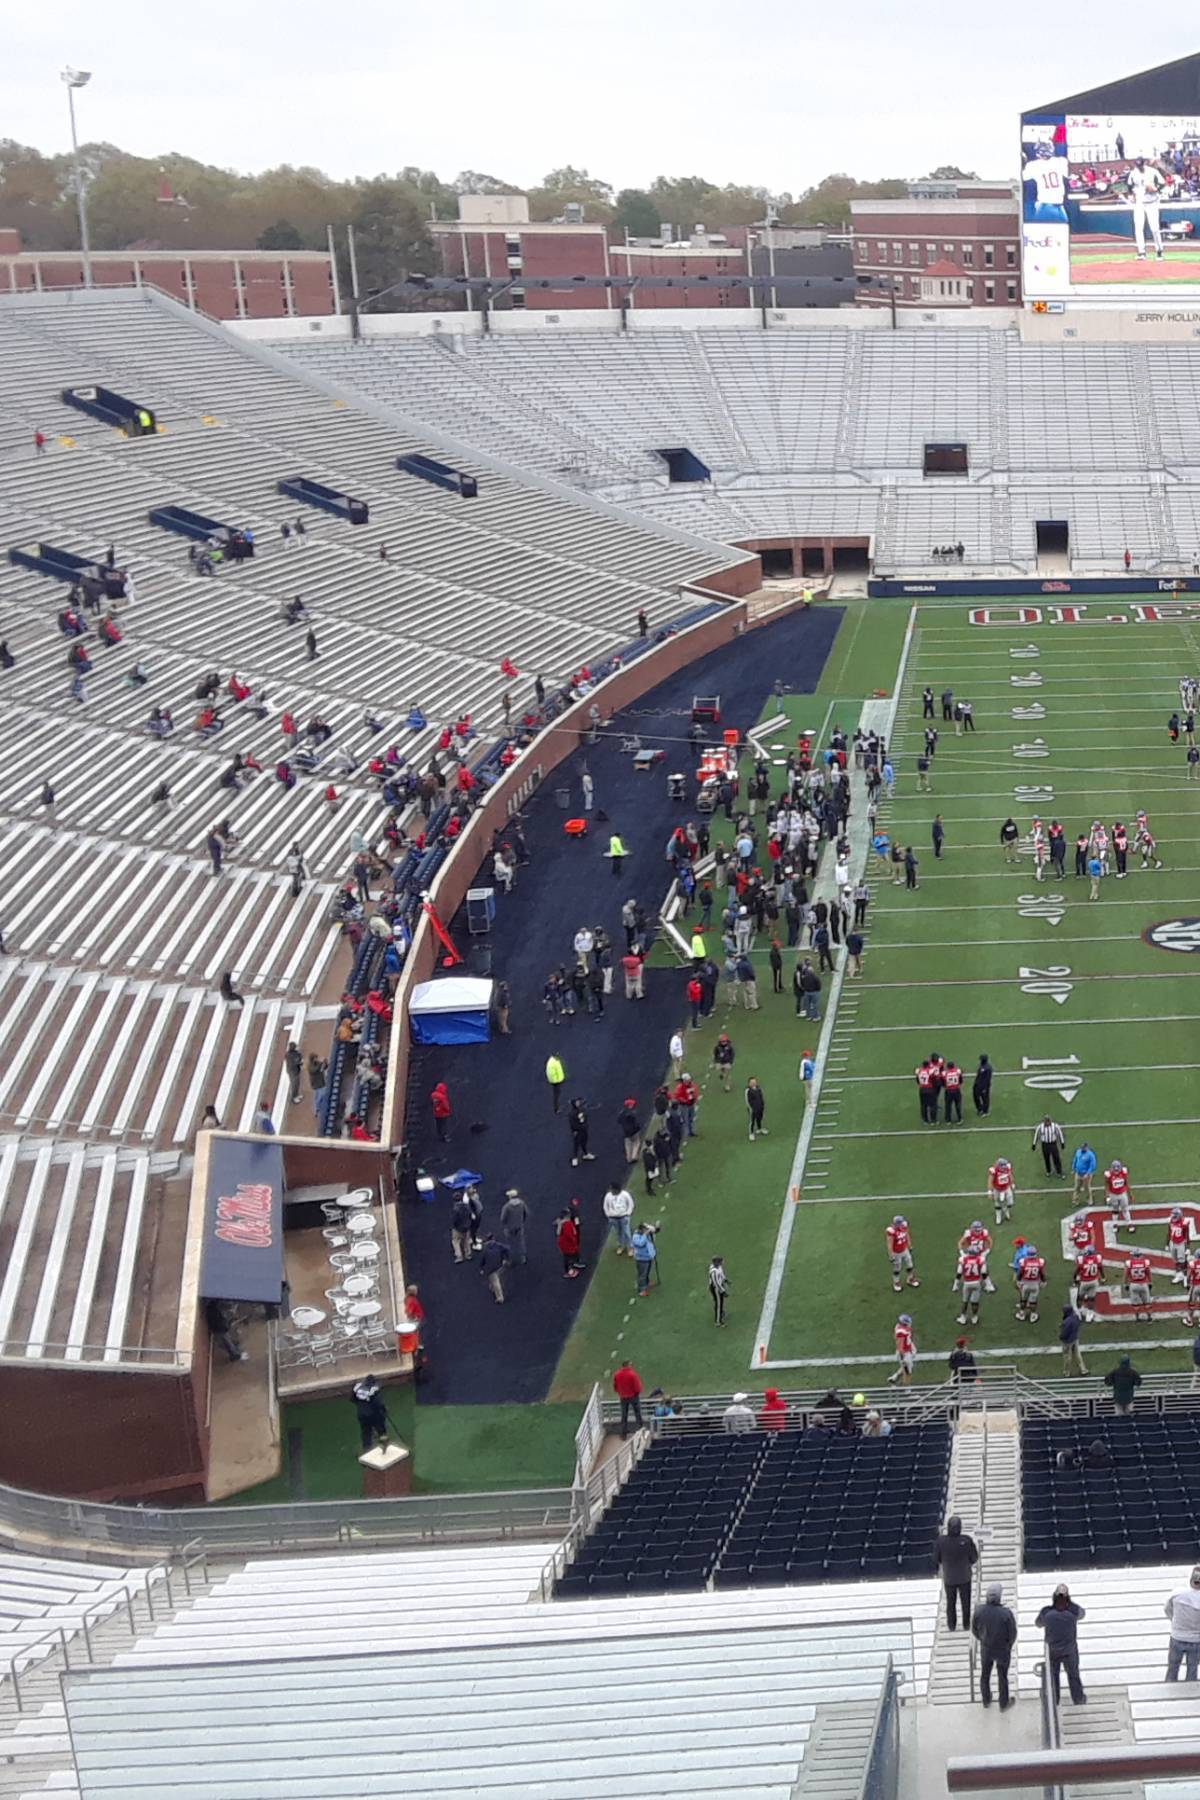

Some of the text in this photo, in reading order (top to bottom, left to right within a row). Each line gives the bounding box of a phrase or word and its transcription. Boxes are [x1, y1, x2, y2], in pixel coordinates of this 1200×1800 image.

[1042, 171, 1059, 189] 10
[1135, 313, 1165, 322] JERRY
[1013, 785, 1055, 802] 50
[1017, 894, 1066, 917] 30
[1018, 965, 1074, 994] 20
[1021, 1053, 1084, 1090] 10
[964, 1263, 980, 1277] 74
[1083, 1263, 1098, 1277] 70
